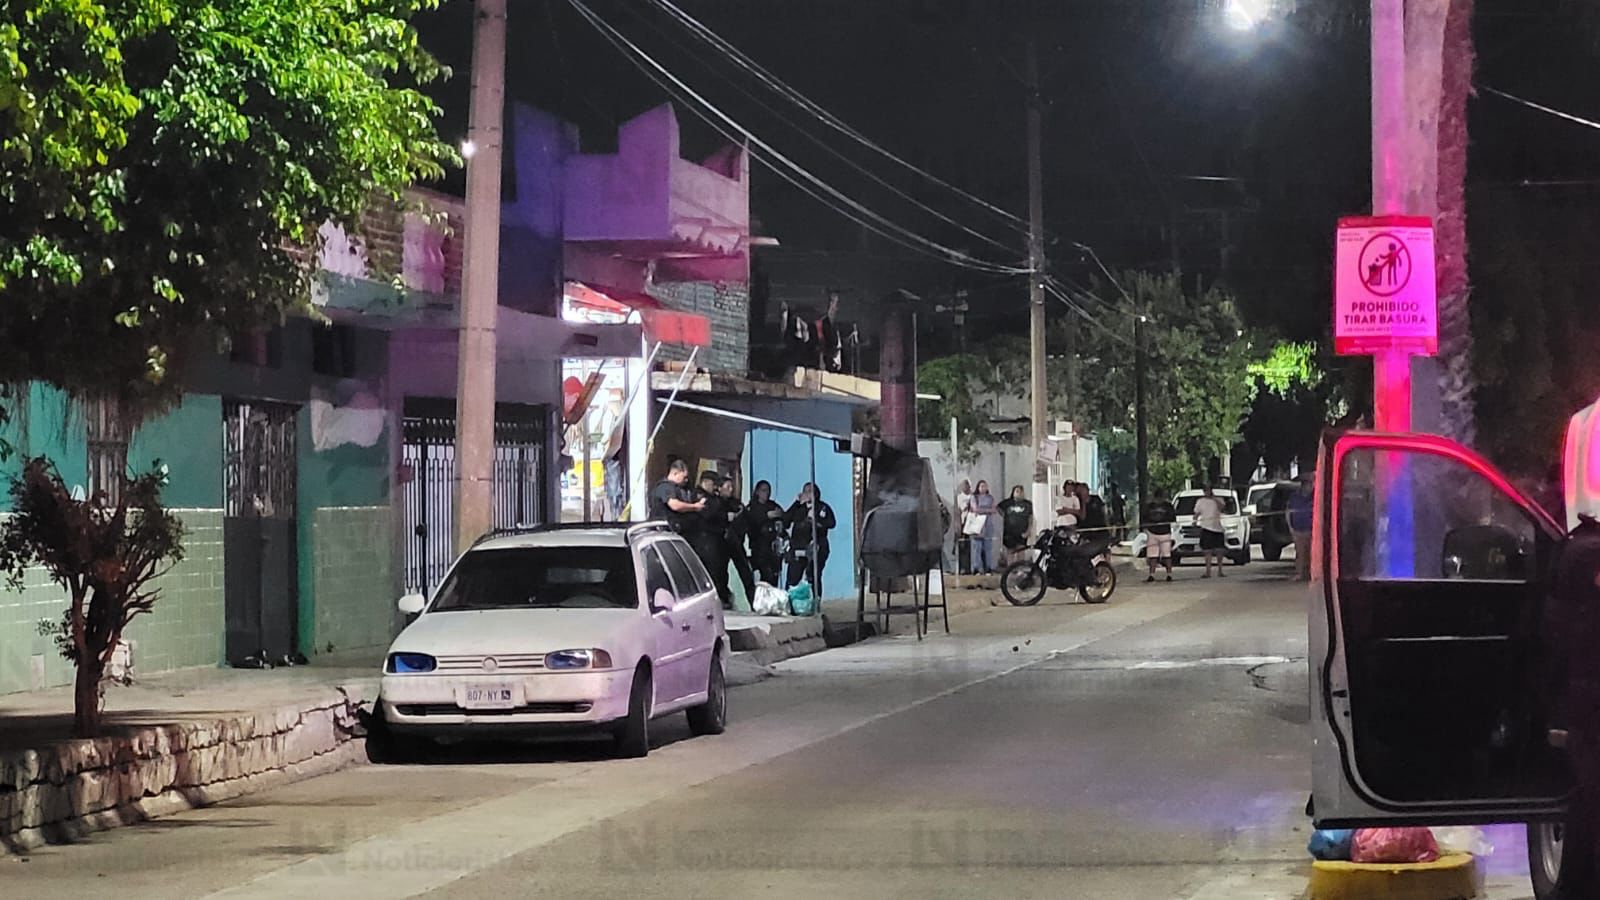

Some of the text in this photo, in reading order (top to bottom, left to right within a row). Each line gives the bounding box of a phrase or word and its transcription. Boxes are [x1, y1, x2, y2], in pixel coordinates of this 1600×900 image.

[1351, 302, 1419, 312] PROHIBIDO
[1344, 314, 1427, 325] TIRAR BASURA
